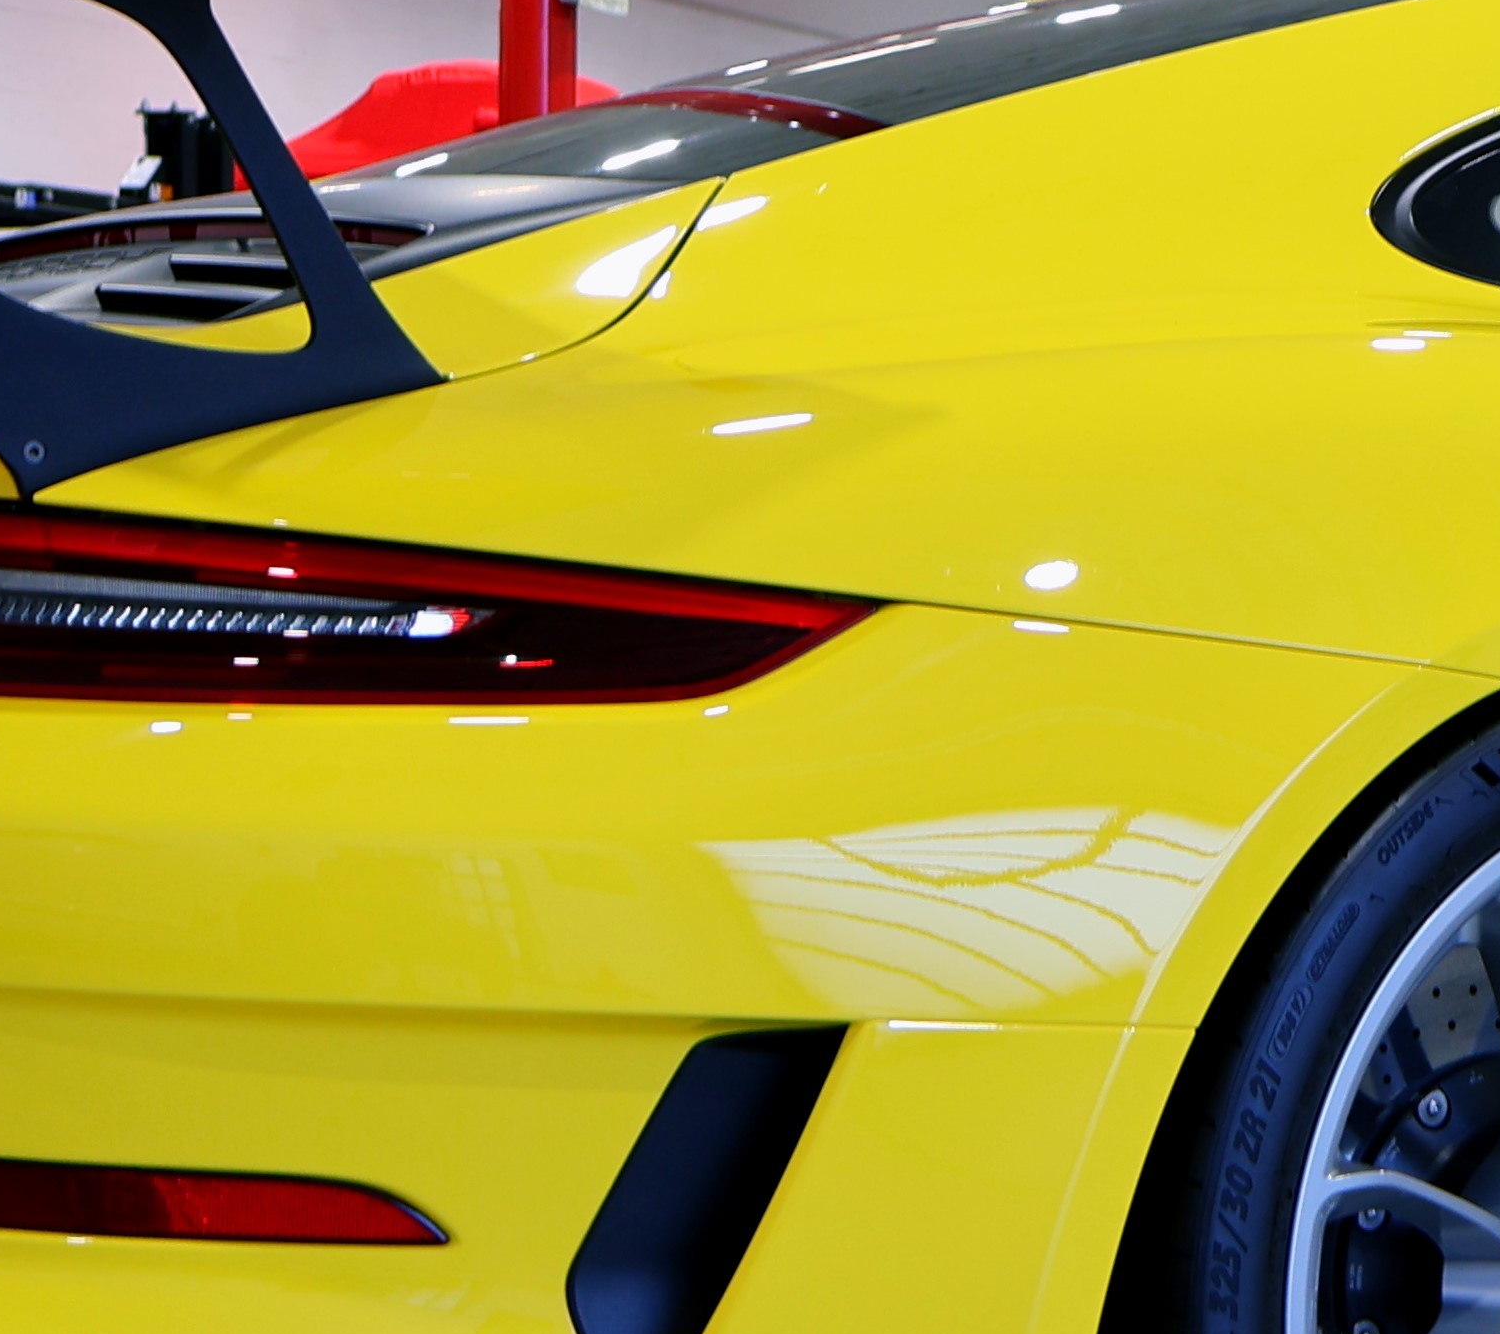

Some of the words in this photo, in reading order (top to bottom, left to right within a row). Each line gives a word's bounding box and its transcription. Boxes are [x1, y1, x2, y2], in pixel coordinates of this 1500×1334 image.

[1377, 801, 1434, 864] OUTSIDE
[1209, 1164, 1253, 1321] 325/30
[1234, 1108, 1266, 1165] ZR
[1250, 1062, 1281, 1111] 21
